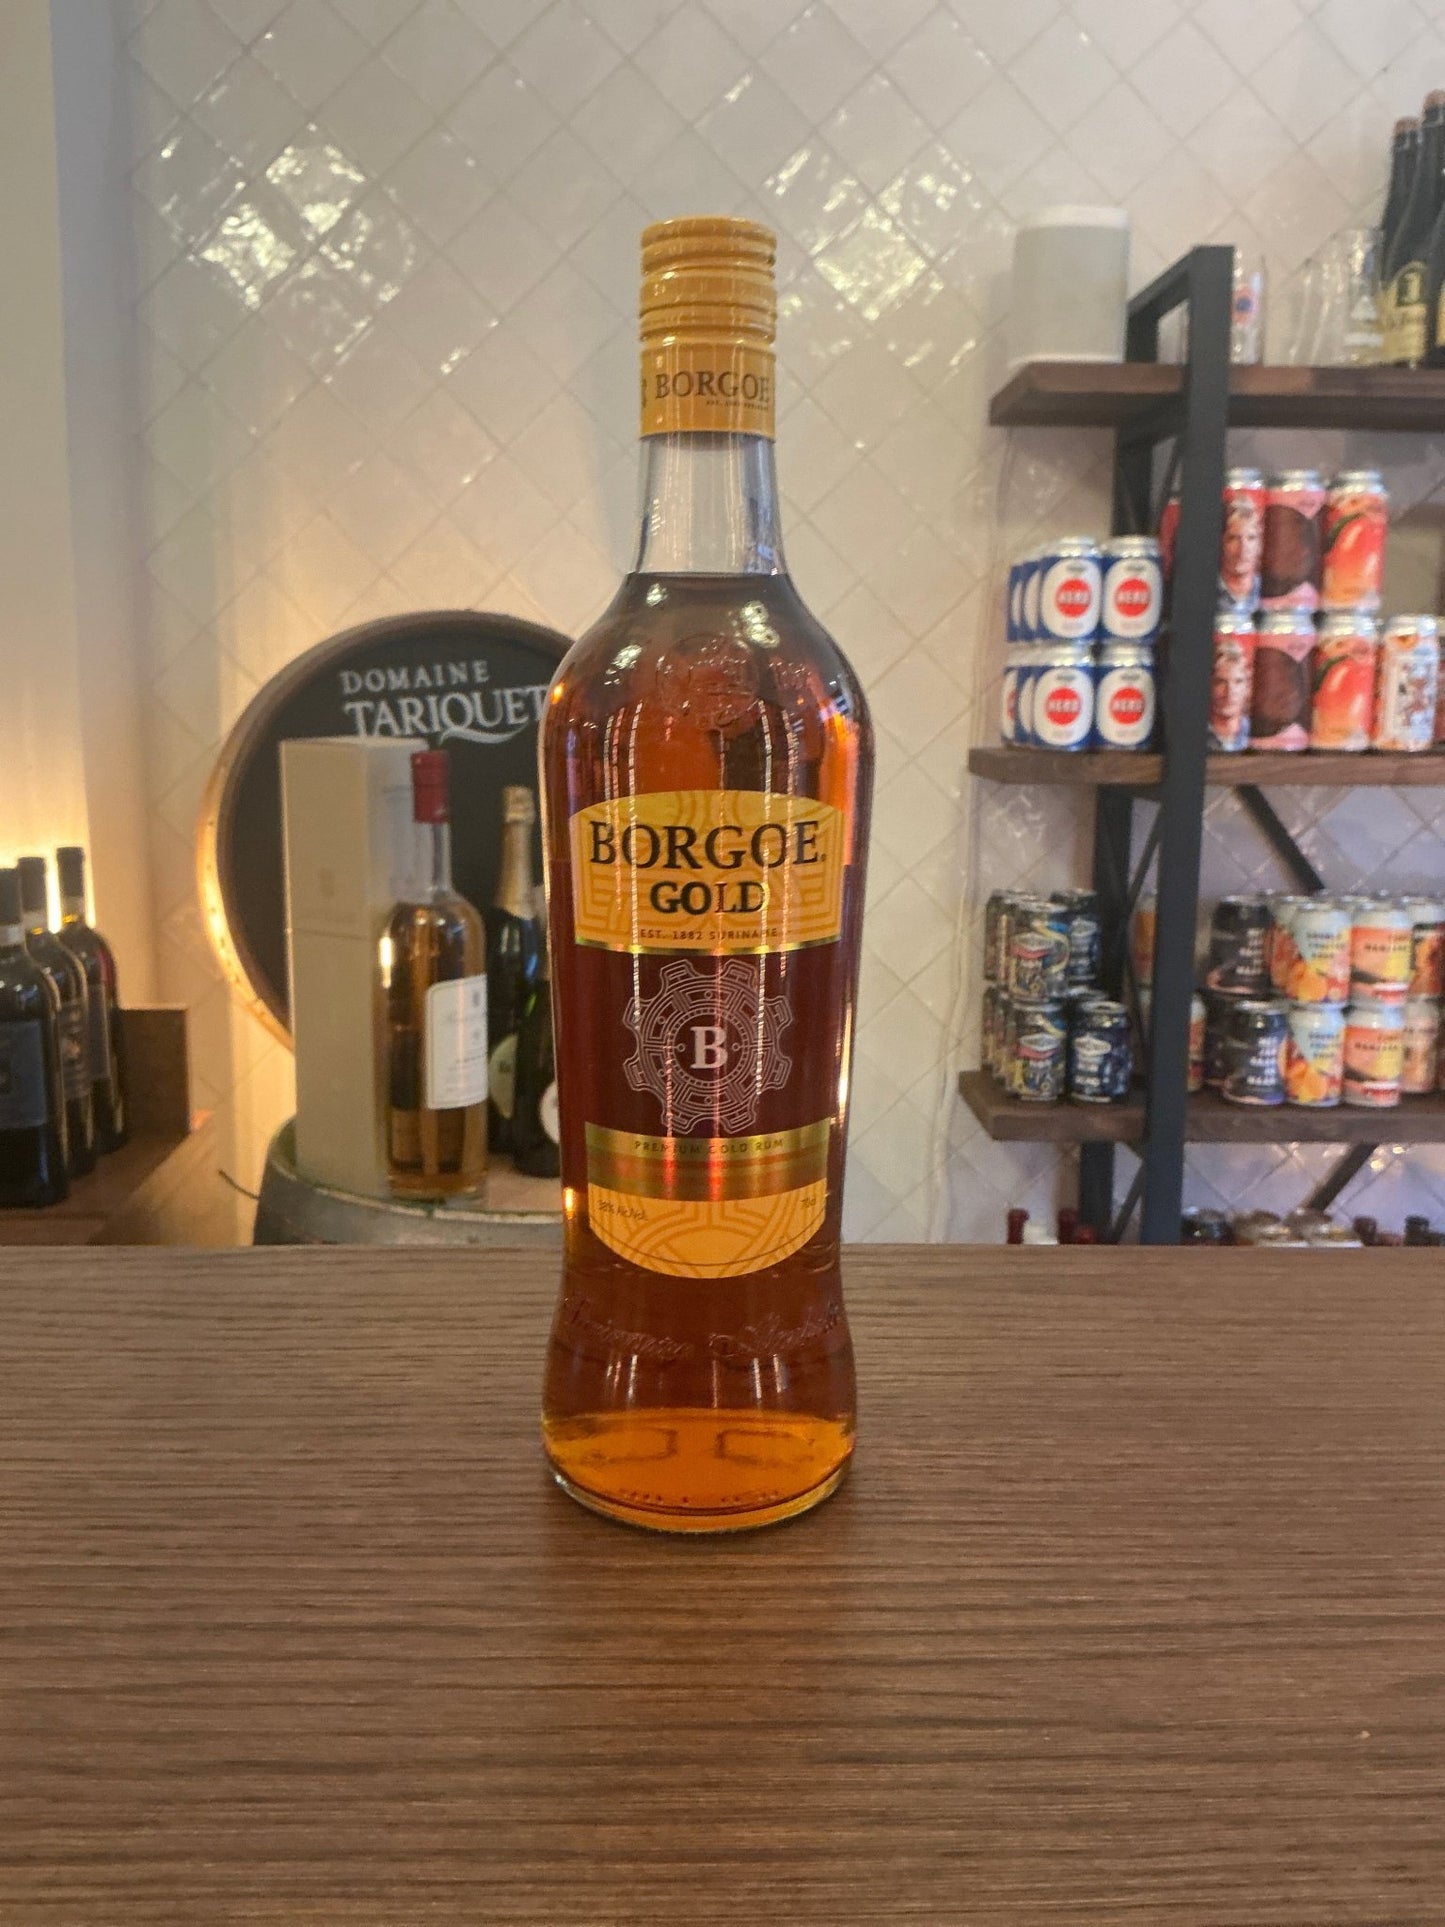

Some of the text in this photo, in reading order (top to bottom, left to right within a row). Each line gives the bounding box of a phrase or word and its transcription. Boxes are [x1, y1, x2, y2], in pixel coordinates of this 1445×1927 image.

[656, 371, 770, 403] BORGOE
[340, 660, 490, 694] DOMAINE
[344, 684, 551, 745] TARIQUET
[590, 820, 820, 869] BORGOE
[650, 881, 769, 915] GOLD
[640, 928, 666, 939] EST.
[672, 930, 703, 940] 1882
[690, 1026, 728, 1069] B
